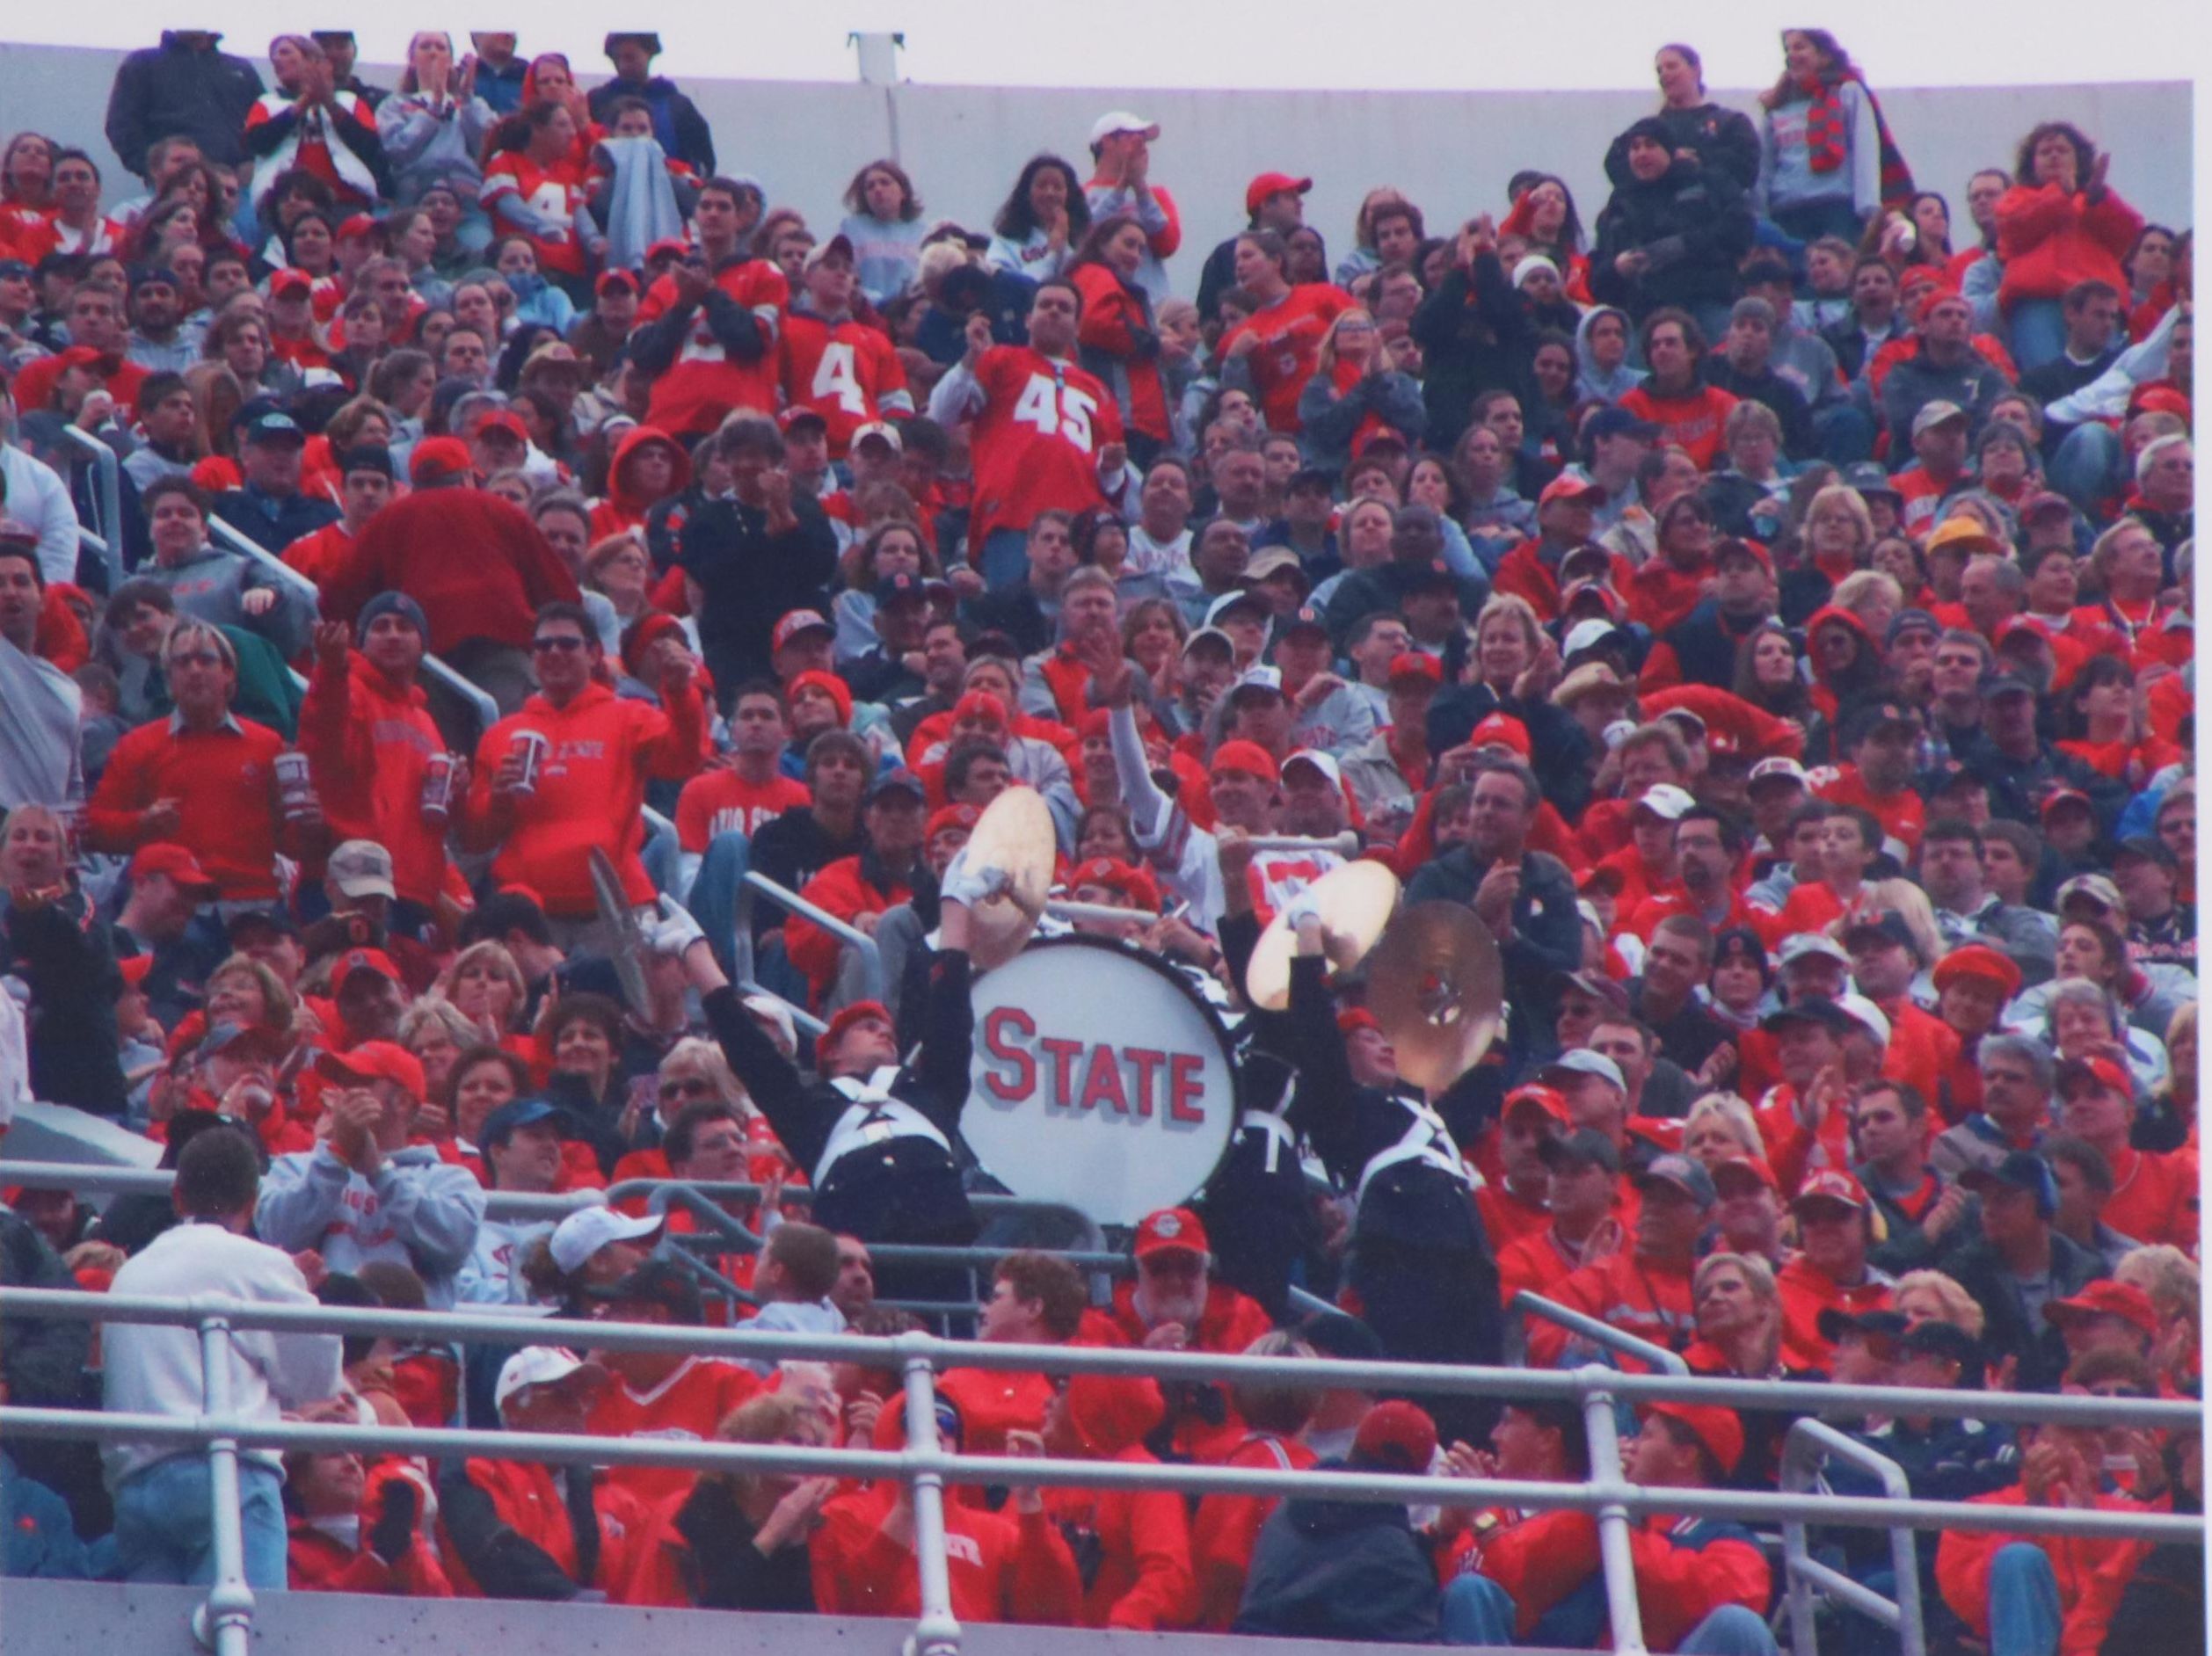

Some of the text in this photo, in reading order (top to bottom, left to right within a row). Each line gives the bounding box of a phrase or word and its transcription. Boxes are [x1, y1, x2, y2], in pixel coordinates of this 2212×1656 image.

[811, 341, 866, 416] 4
[1013, 371, 1098, 454] 45
[984, 1006, 1205, 1123] STATE
